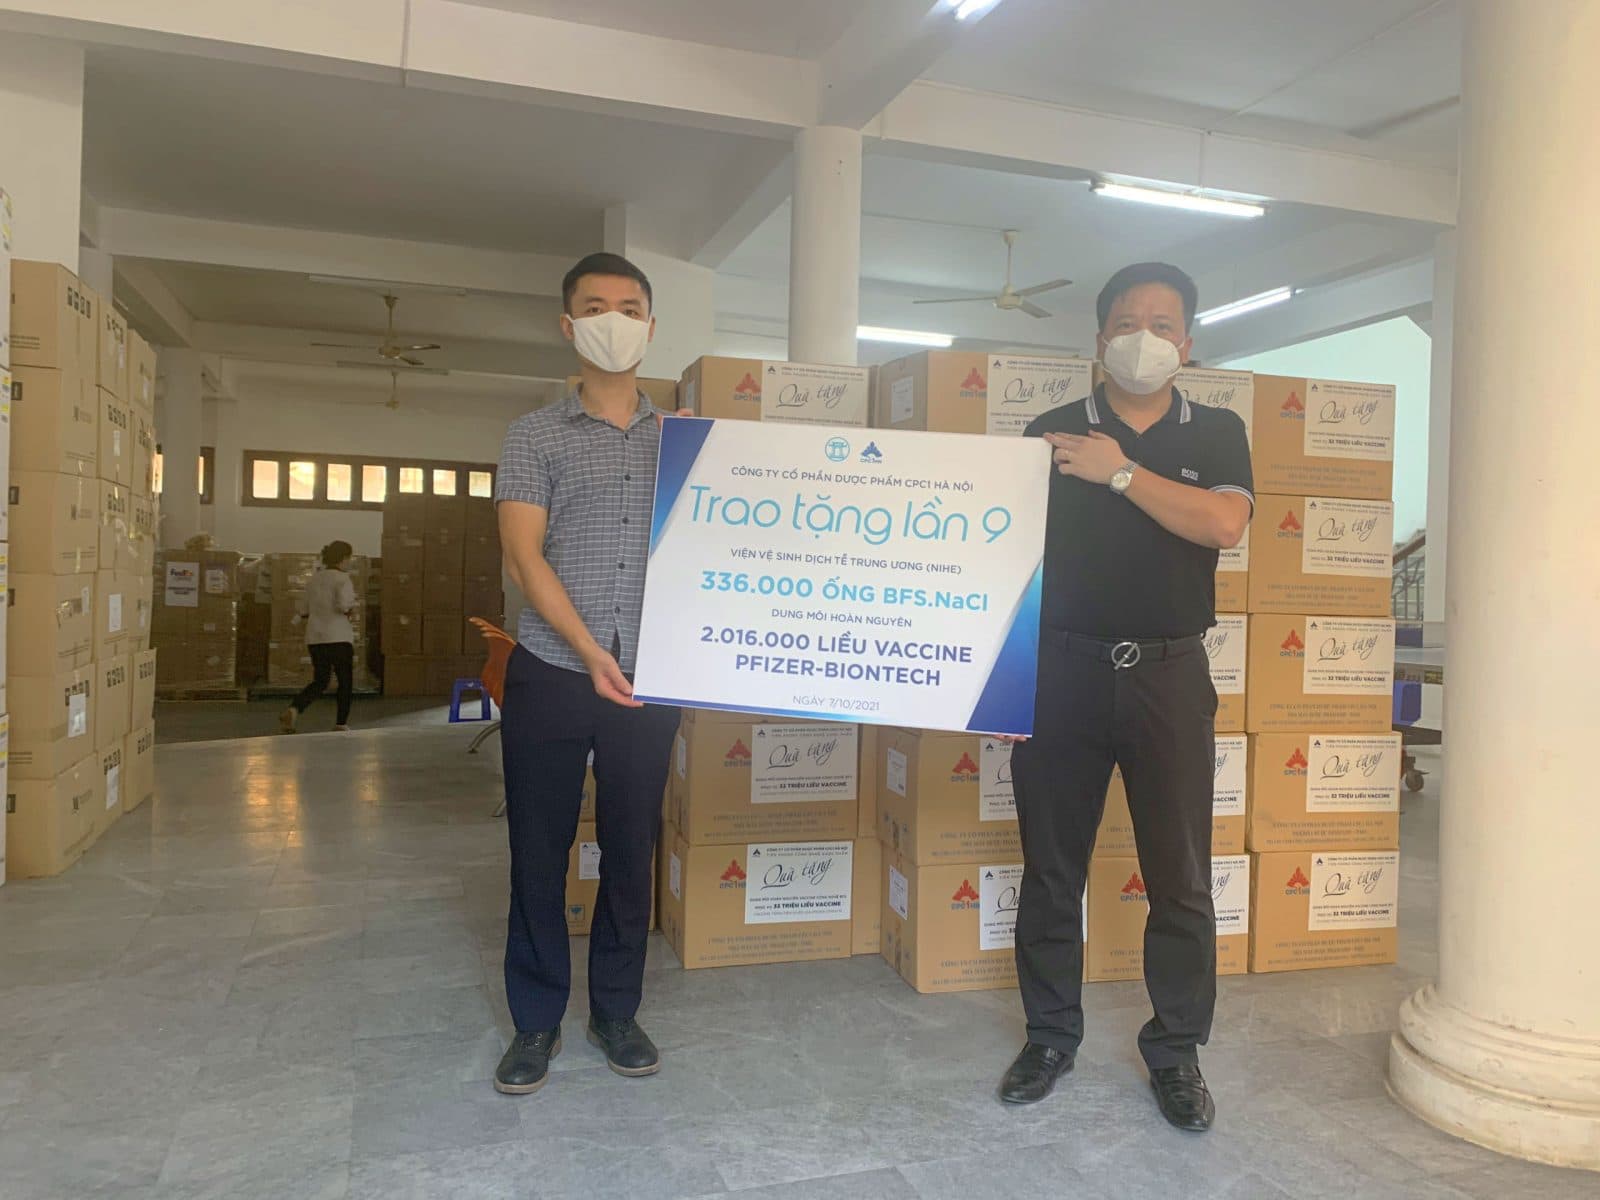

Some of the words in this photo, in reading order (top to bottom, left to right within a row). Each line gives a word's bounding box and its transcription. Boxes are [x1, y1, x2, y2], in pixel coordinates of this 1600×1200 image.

[731, 466, 763, 478] CÔNG
[766, 470, 779, 478] TY
[834, 474, 867, 486] DƯỢC
[934, 480, 950, 490] HÀ
[953, 482, 974, 493] NỘI
[690, 485, 782, 528] Trao
[792, 493, 893, 545] tặng
[903, 496, 969, 542] lần
[982, 506, 1012, 544] 9
[730, 548, 756, 560] VIỆN
[759, 550, 773, 562] VỆ
[776, 552, 802, 562] SINH
[805, 554, 832, 566] DỊCH
[851, 557, 887, 569] TRUNG
[890, 559, 923, 572] ƯƠNG
[926, 562, 962, 575] (NIHE)
[700, 570, 813, 598] 336.000
[822, 576, 876, 603] ỐNG
[883, 587, 988, 612] BFS.NaCl
[771, 608, 803, 619] DUNG
[806, 609, 828, 621] MÔI
[830, 612, 861, 624] HOÀN
[866, 614, 912, 628] NGUYÊN
[700, 626, 810, 650] 2.016.000
[818, 630, 867, 654] LIỀU
[874, 640, 972, 663] VACCINE
[1318, 638, 1346, 661] Quà
[736, 654, 940, 686] PFIZER-BIONTECH
[828, 698, 880, 712] 7/10/2021
[767, 744, 800, 770] Quà
[1320, 755, 1350, 780] Quà
[760, 864, 794, 891] Quà
[802, 858, 833, 886] tặng
[1322, 872, 1351, 897] Quà
